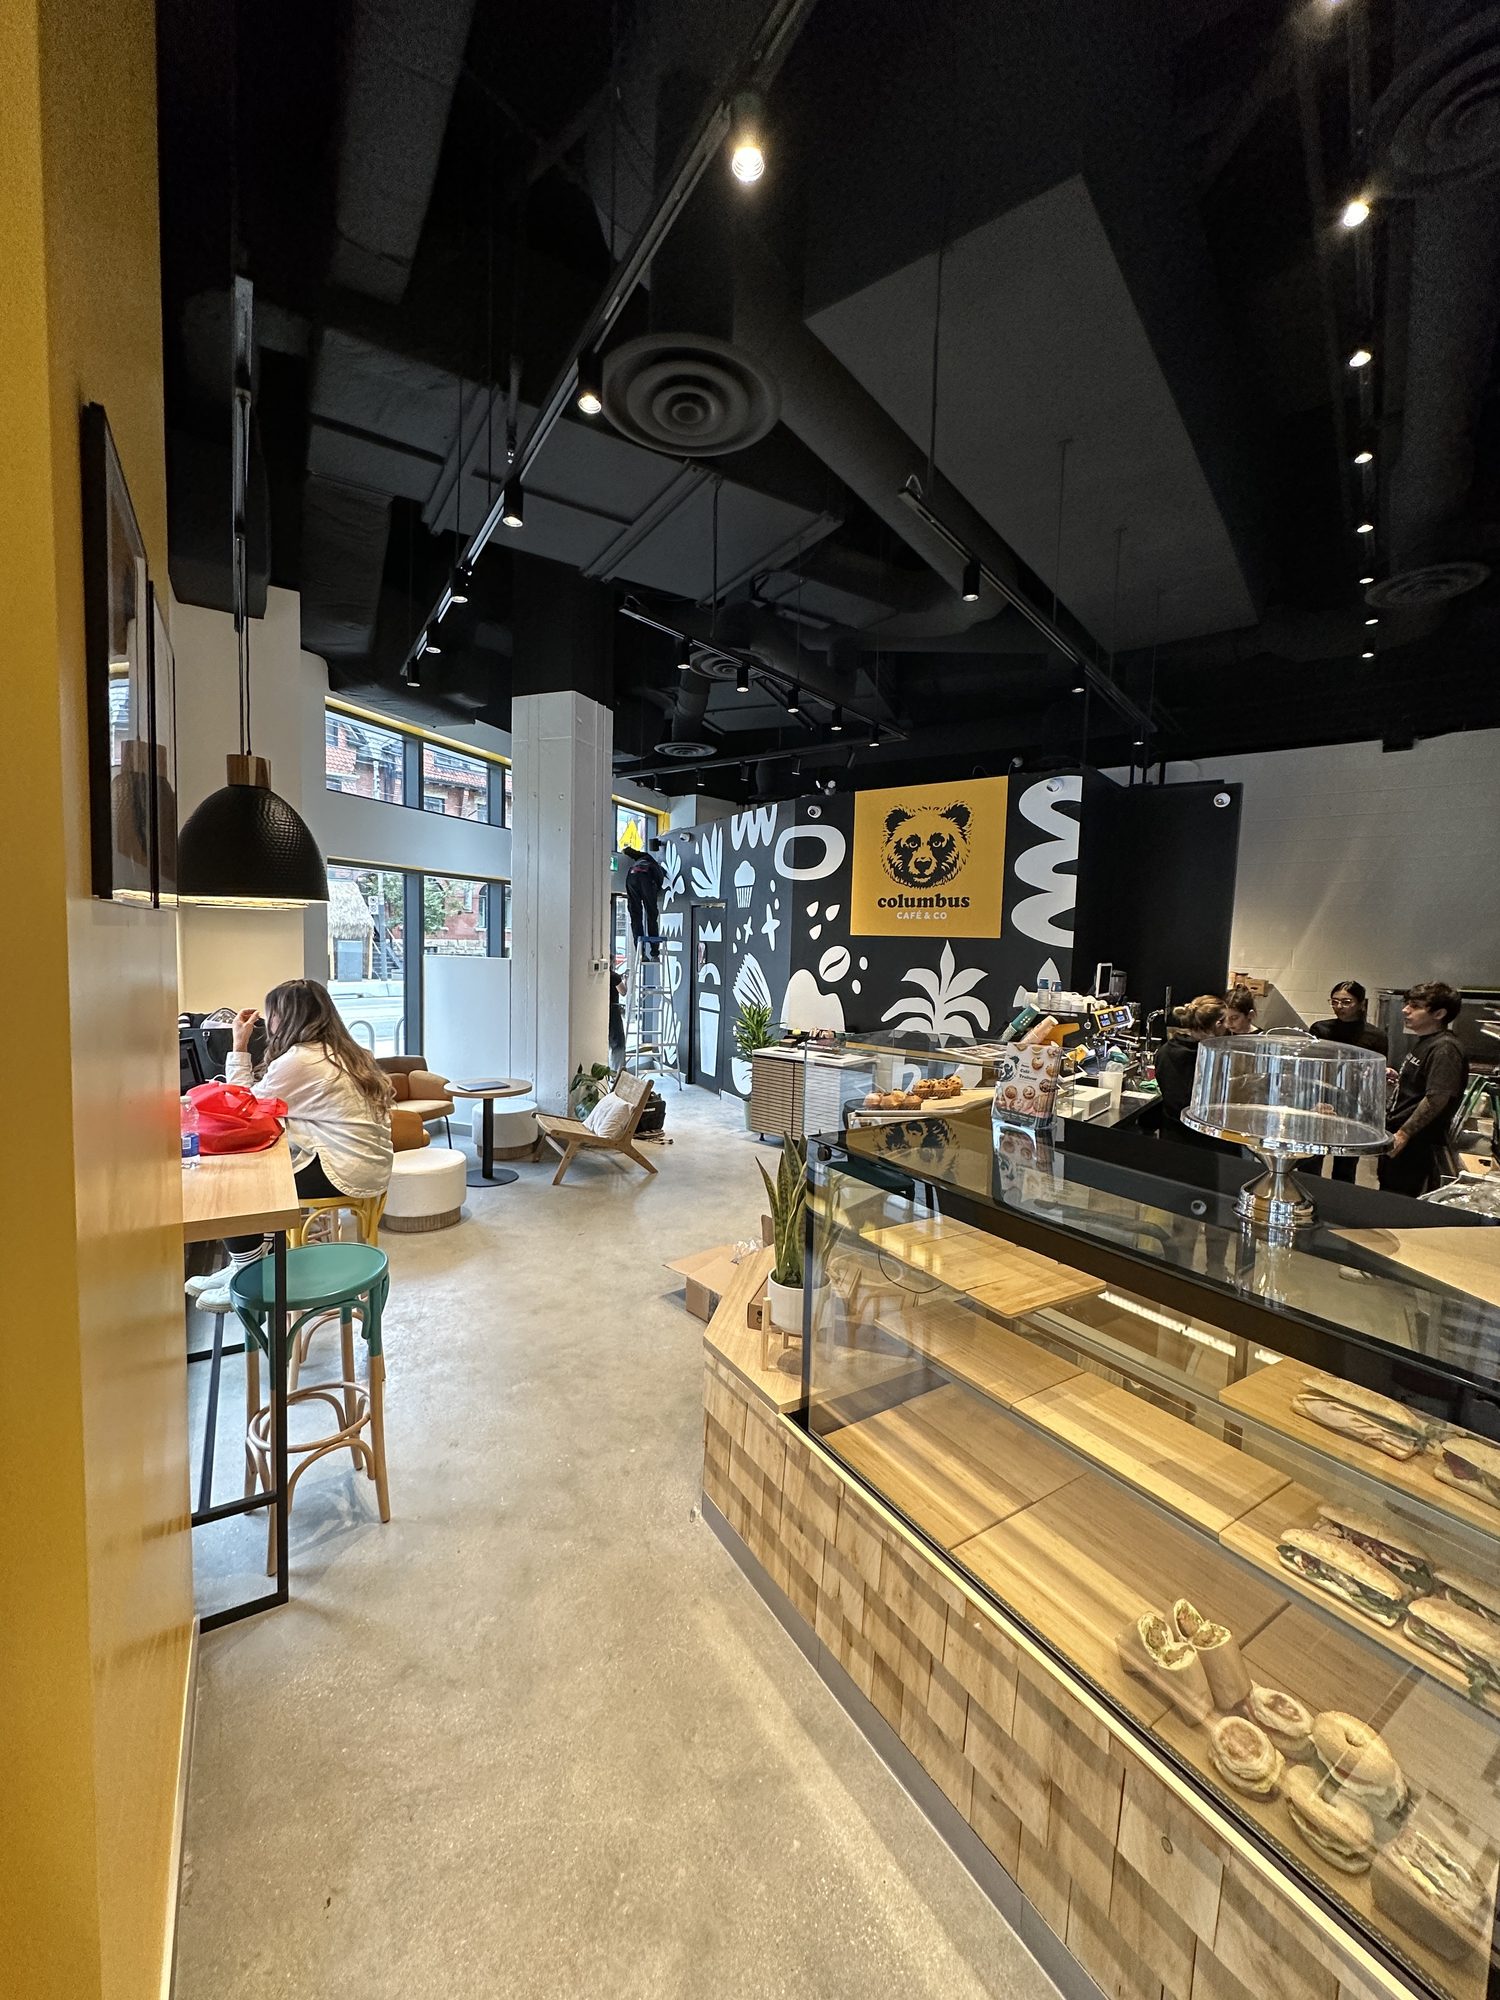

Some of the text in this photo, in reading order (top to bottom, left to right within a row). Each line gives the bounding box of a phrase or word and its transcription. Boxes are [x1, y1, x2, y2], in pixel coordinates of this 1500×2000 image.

[877, 893, 970, 908] columbus
[896, 910, 947, 920] CAFÉ & CO
